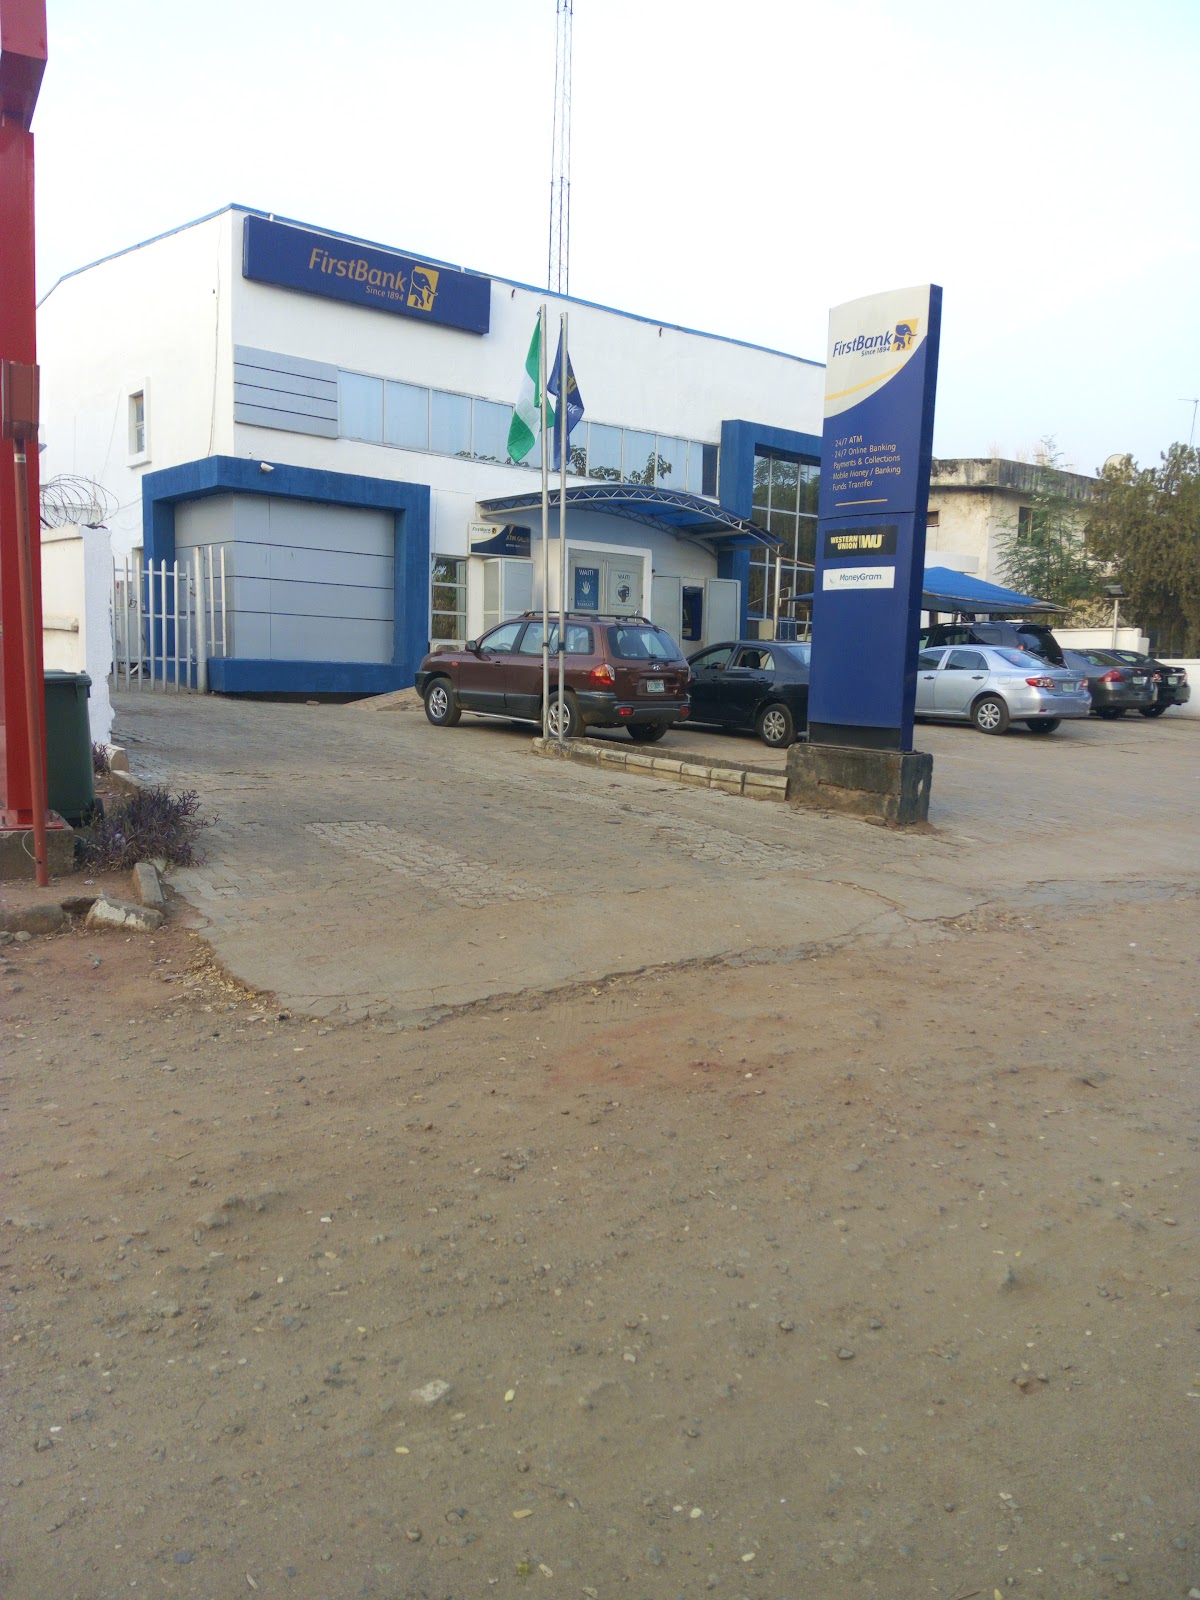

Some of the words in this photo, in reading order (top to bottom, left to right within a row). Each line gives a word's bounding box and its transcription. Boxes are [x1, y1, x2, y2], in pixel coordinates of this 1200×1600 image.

[309, 248, 407, 292] FirstBank
[365, 285, 386, 298] Since
[387, 290, 404, 302] 1894
[833, 331, 893, 357] FirstBank
[861, 349, 876, 357] Since
[835, 438, 847, 447] 24/7
[849, 435, 862, 444] ATM
[834, 449, 847, 458] 24/7
[848, 447, 867, 456] Online
[870, 444, 896, 452] Banking
[834, 460, 856, 470] Payments
[864, 455, 900, 465] Collections
[833, 472, 848, 480] Mobile
[849, 470, 869, 478] Money
[875, 466, 901, 475] Banking
[833, 483, 846, 491] Funds
[849, 479, 873, 488] Transfer
[831, 535, 858, 543] WESTERN
[861, 534, 882, 549] WU
[839, 573, 882, 582] MoneyGram
